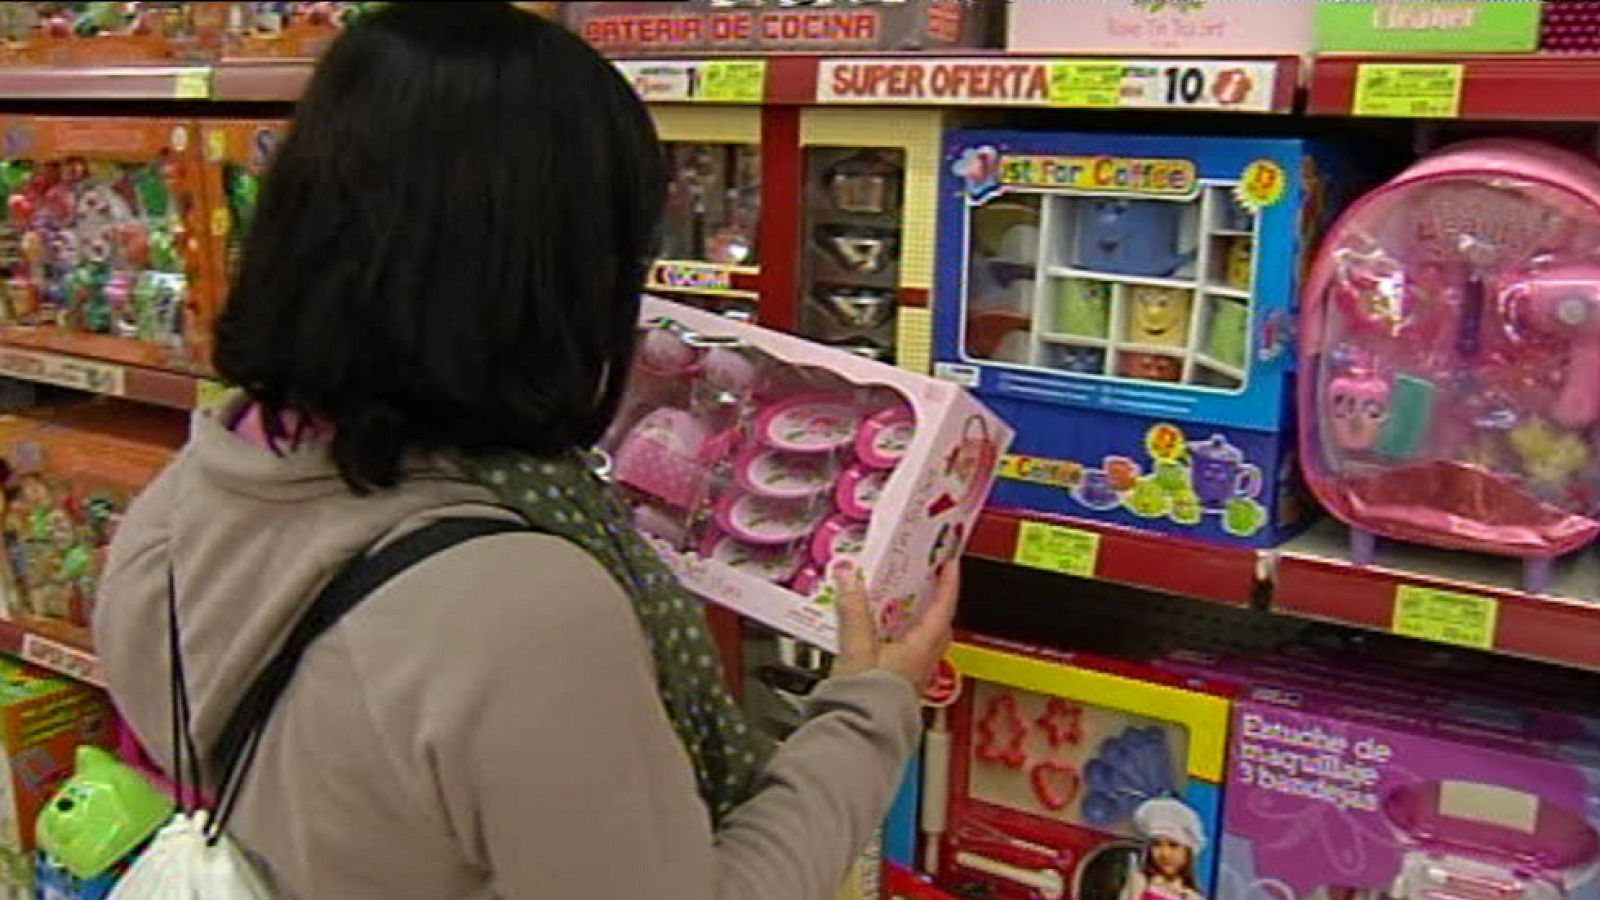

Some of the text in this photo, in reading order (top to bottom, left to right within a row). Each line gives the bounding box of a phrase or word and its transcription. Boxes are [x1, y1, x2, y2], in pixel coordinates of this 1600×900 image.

[584, 14, 876, 42] BATERIA DE COCINA
[833, 64, 924, 97] SUPER
[931, 64, 1049, 98] OFERTA
[1165, 67, 1205, 104] 10
[1092, 154, 1188, 191] Coffee
[1243, 713, 1392, 764] Estuche de
[1241, 743, 1379, 787] maquillaje
[1238, 761, 1378, 813] 3 bandejas
